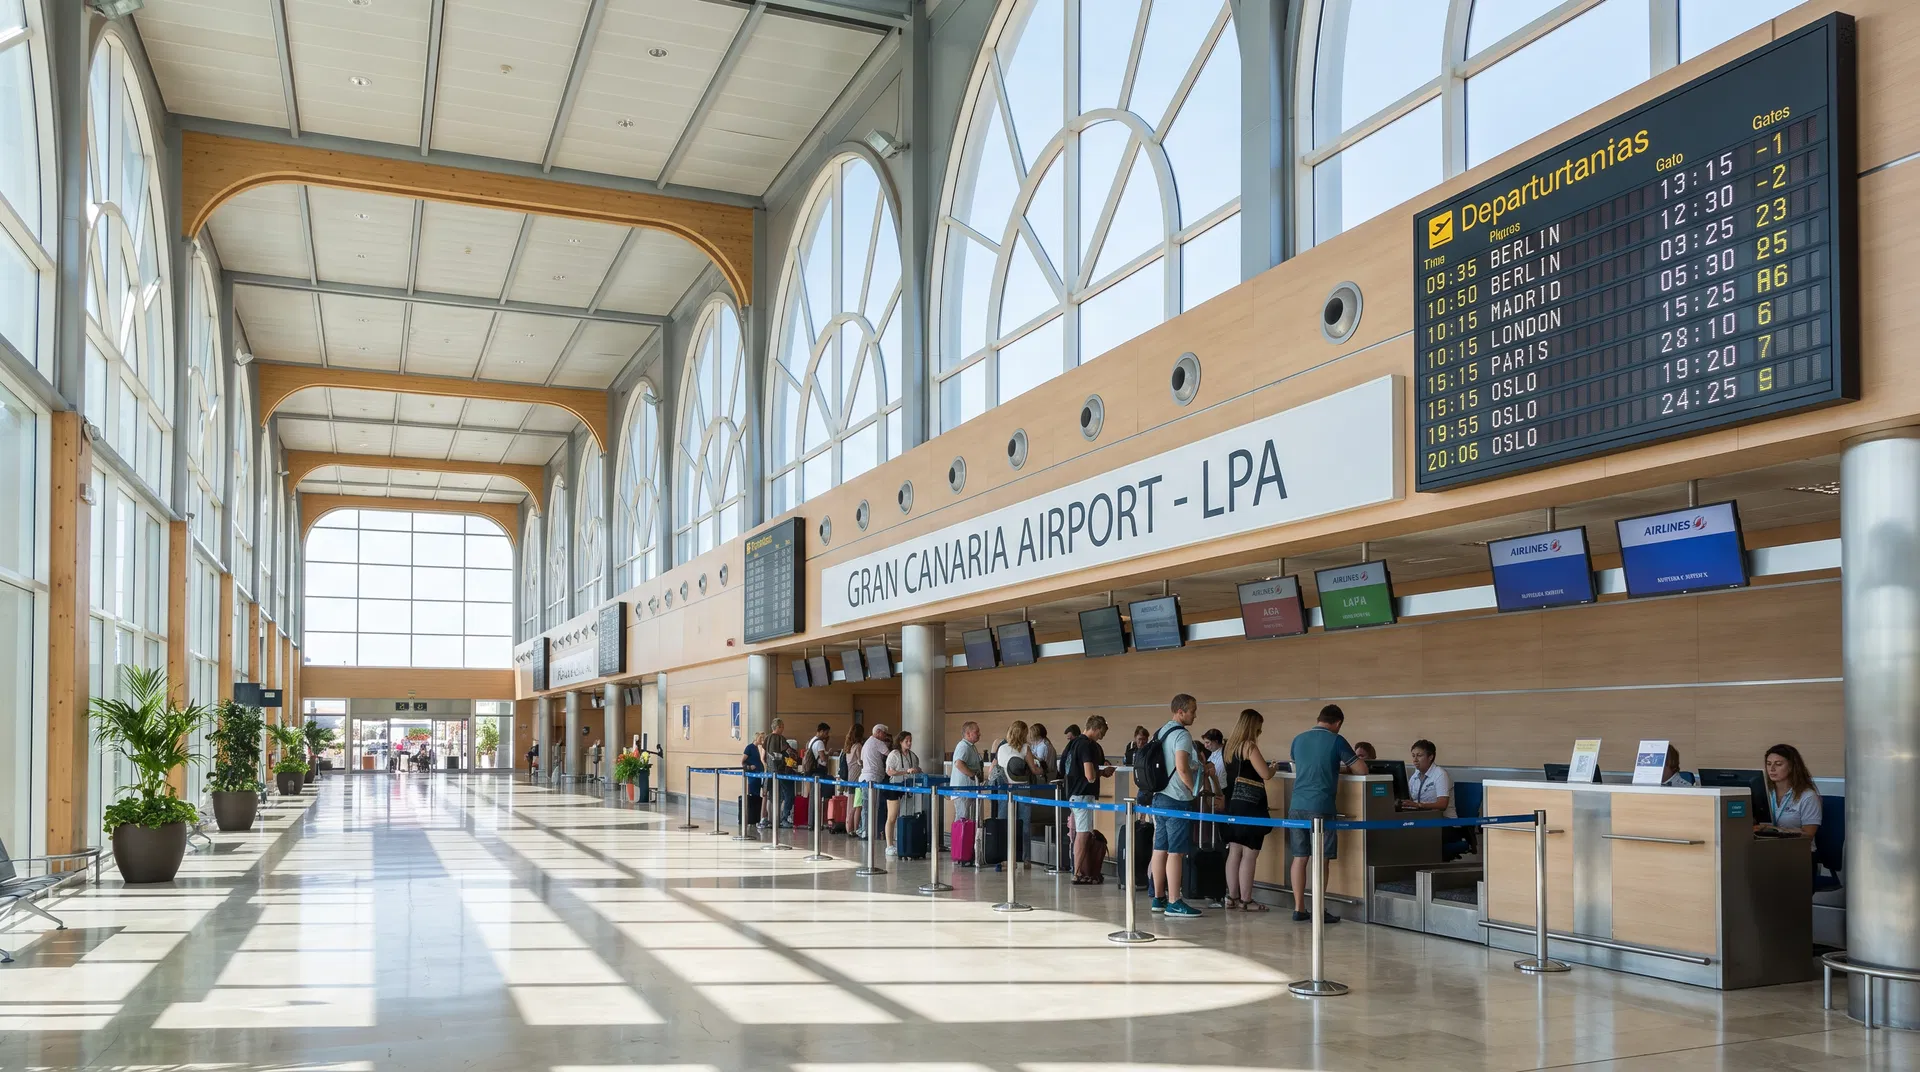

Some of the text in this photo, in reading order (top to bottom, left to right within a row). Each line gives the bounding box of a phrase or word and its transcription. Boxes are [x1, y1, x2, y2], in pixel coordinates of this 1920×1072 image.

[1461, 129, 1650, 232] Departurtanias
[1656, 153, 1684, 172] Gato
[1752, 106, 1790, 130] Gates
[1426, 258, 1477, 294] 09:35
[1490, 223, 1560, 269] BERLIN
[1660, 152, 1733, 200] 13:15
[1428, 285, 1477, 319] 10:50
[1491, 251, 1560, 296] BERLIN
[1661, 184, 1733, 230] 12:30
[1428, 197, 1787, 344] 10:15 MADRID 03:25 23
[1428, 336, 1478, 369] 10:15
[1491, 307, 1561, 348] LONDON
[1660, 248, 1735, 291] 05:30
[1428, 263, 1788, 394] 15:15 PARIS 15:25 A6
[1428, 301, 1772, 420] 15:15 OSLO 28:10 6
[1427, 442, 1479, 471] 20:06
[1492, 427, 1537, 455] OSLO
[1661, 376, 1736, 415] 24:25
[1428, 334, 1771, 445] 19:55 OSLO 19:20 7
[847, 558, 899, 609] GRAN
[904, 525, 1010, 595] CANARIA
[1016, 474, 1163, 567] AIRPORT
[1201, 438, 1288, 520] LPA
[1332, 573, 1360, 585] AIRLINES
[1510, 541, 1549, 557] AIRLINES
[1644, 519, 1691, 537] AIRLINES
[1251, 586, 1275, 597] AIRLINES
